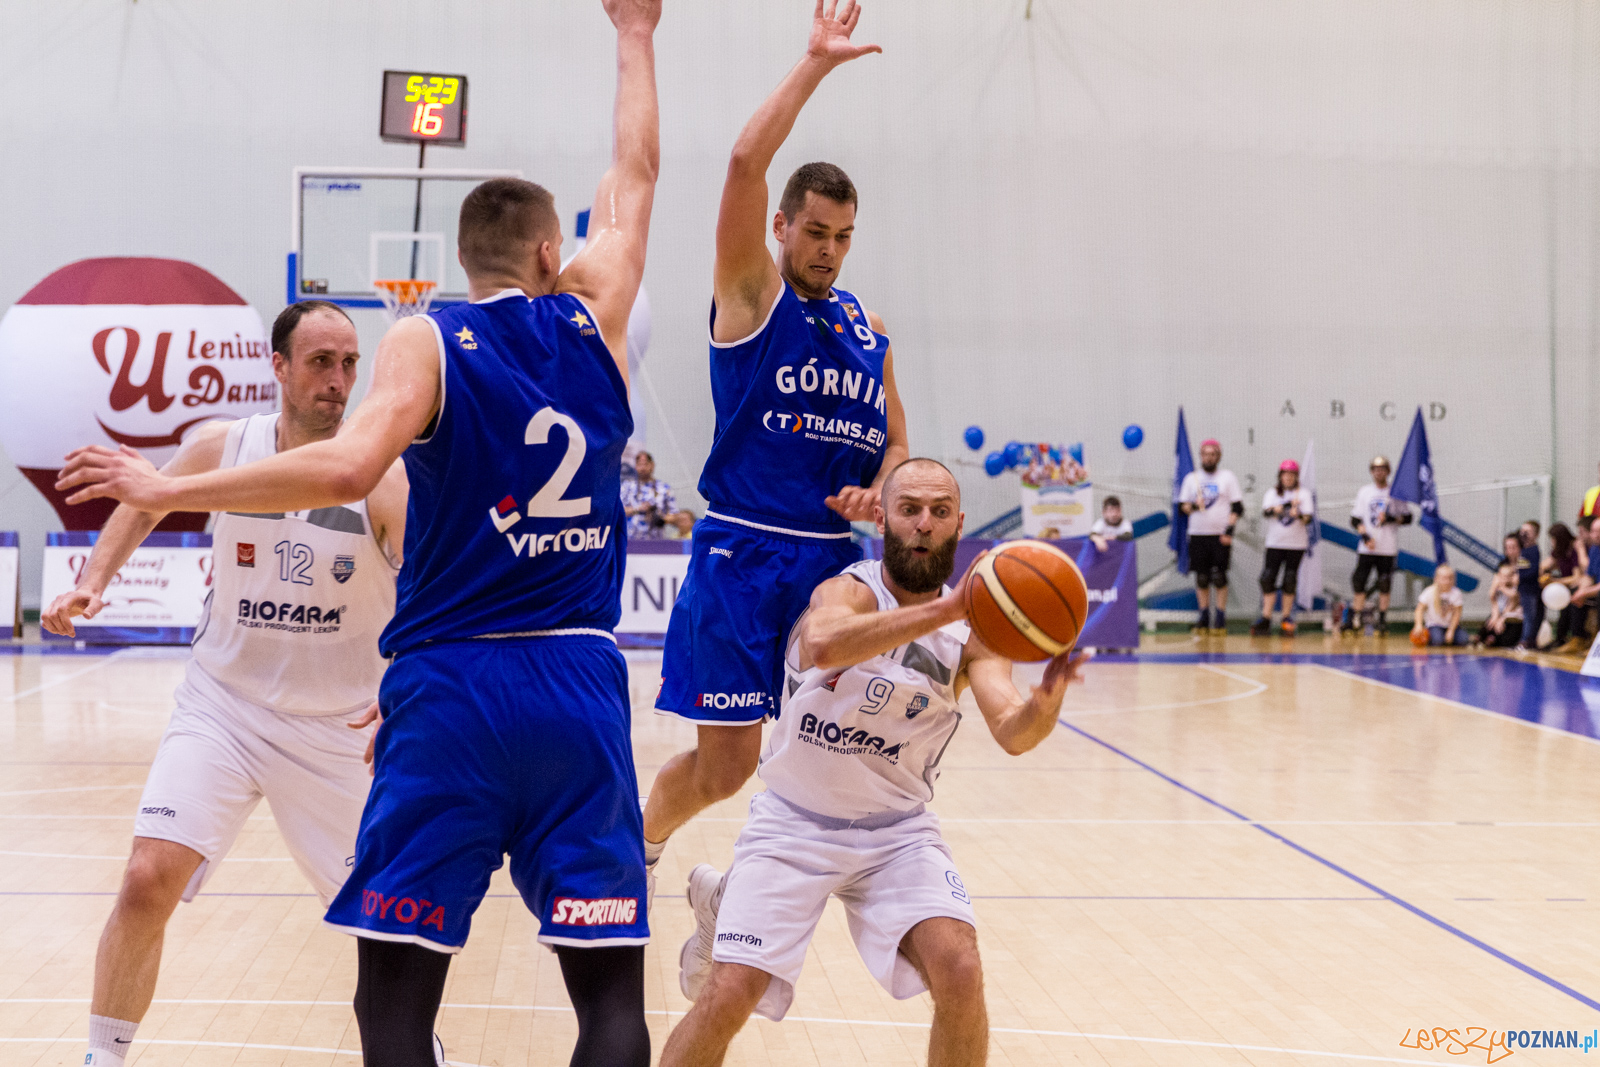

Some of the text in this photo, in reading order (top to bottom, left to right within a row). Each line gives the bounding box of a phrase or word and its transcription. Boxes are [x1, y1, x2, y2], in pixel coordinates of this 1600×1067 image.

[405, 75, 459, 104] 5:23
[411, 102, 444, 137] 16
[461, 342, 478, 350] 982
[854, 324, 877, 350] 9
[92, 326, 175, 413] U
[775, 357, 886, 416] GÓRNIK
[1281, 399, 1296, 418] A
[1379, 401, 1397, 421] C
[1429, 401, 1447, 421] D
[803, 413, 885, 447] TRANS.EU
[524, 406, 591, 518] 2
[274, 540, 314, 586] 12
[237, 618, 263, 629] POLSKI
[264, 621, 312, 634] PRODUCENT
[858, 676, 895, 715] 9
[798, 733, 826, 749] POLSKI
[828, 744, 868, 755] PRODENT
[945, 870, 971, 905] 9
[361, 888, 446, 931] TOYOTA
[551, 898, 637, 925] SPORTING
[717, 932, 763, 947] macron
